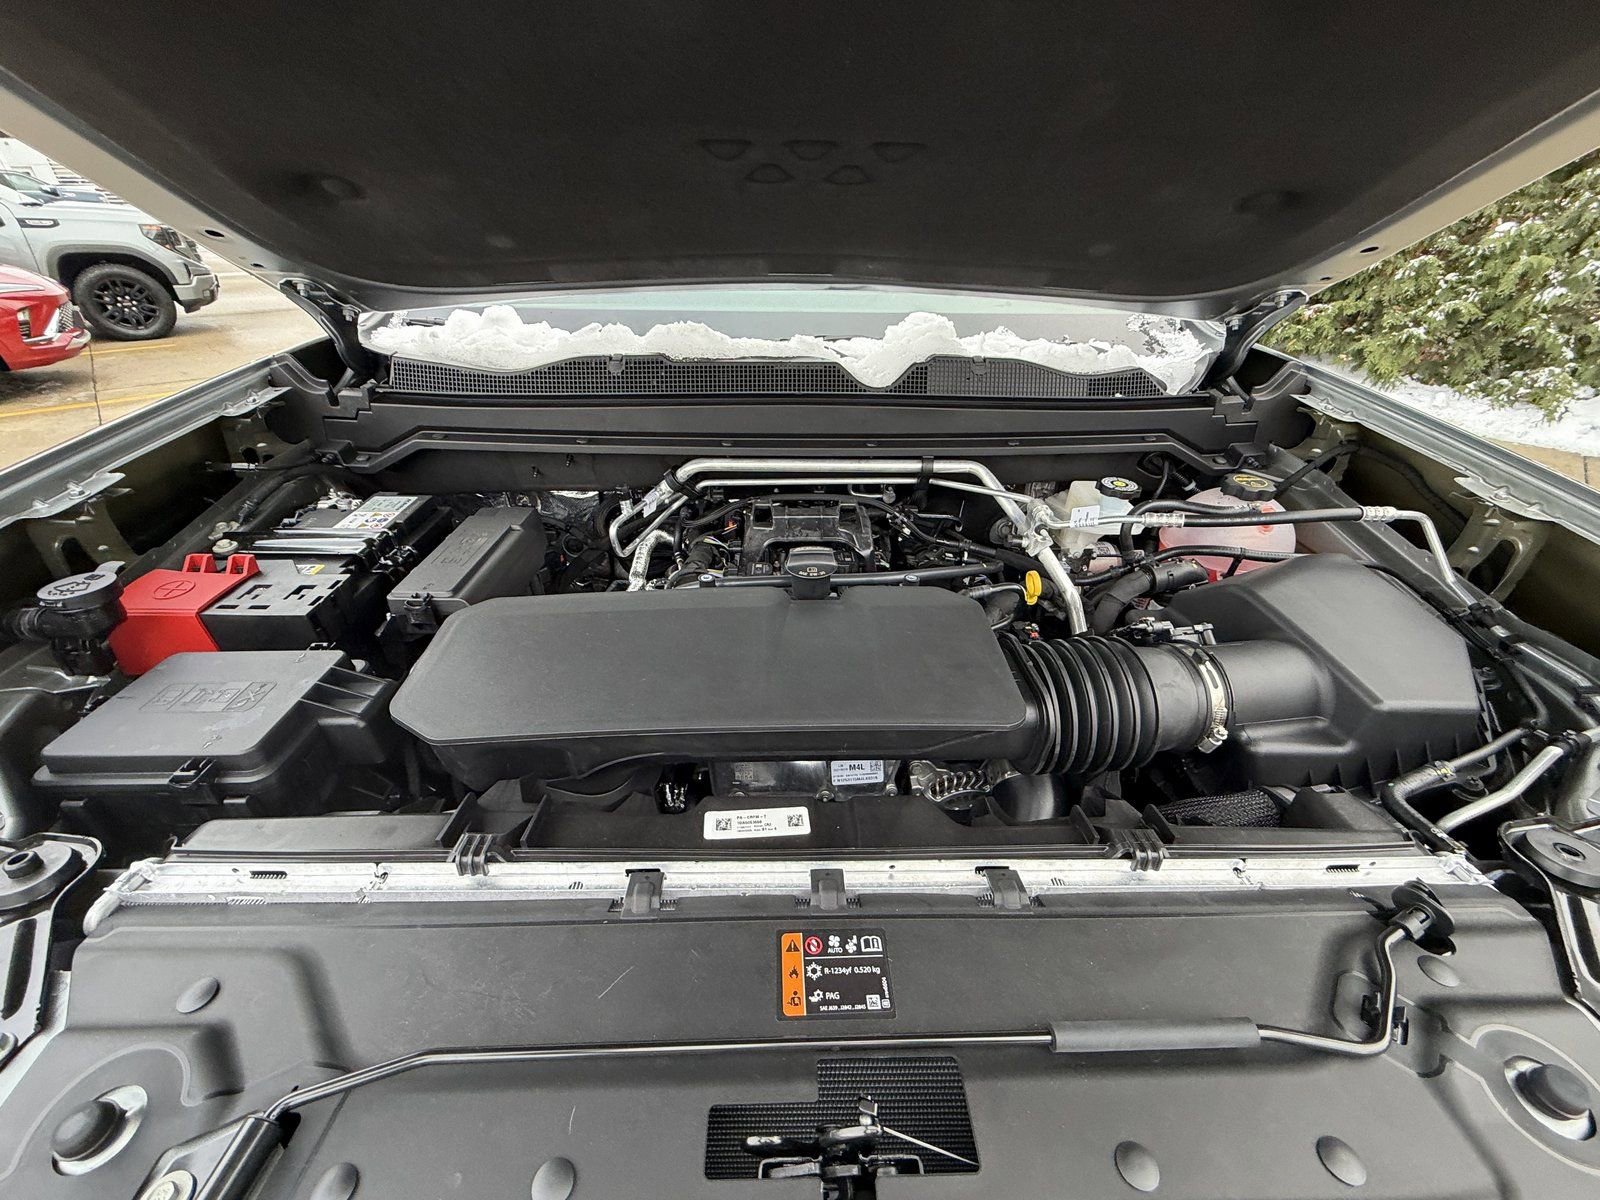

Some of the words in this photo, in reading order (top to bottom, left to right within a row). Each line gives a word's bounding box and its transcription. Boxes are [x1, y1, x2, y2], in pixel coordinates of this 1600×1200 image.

[849, 763, 865, 771] M4L
[824, 966, 852, 975] R-1234yf
[854, 965, 871, 974] 0.520
[872, 965, 880, 974] kg
[825, 992, 840, 1000] PAG
